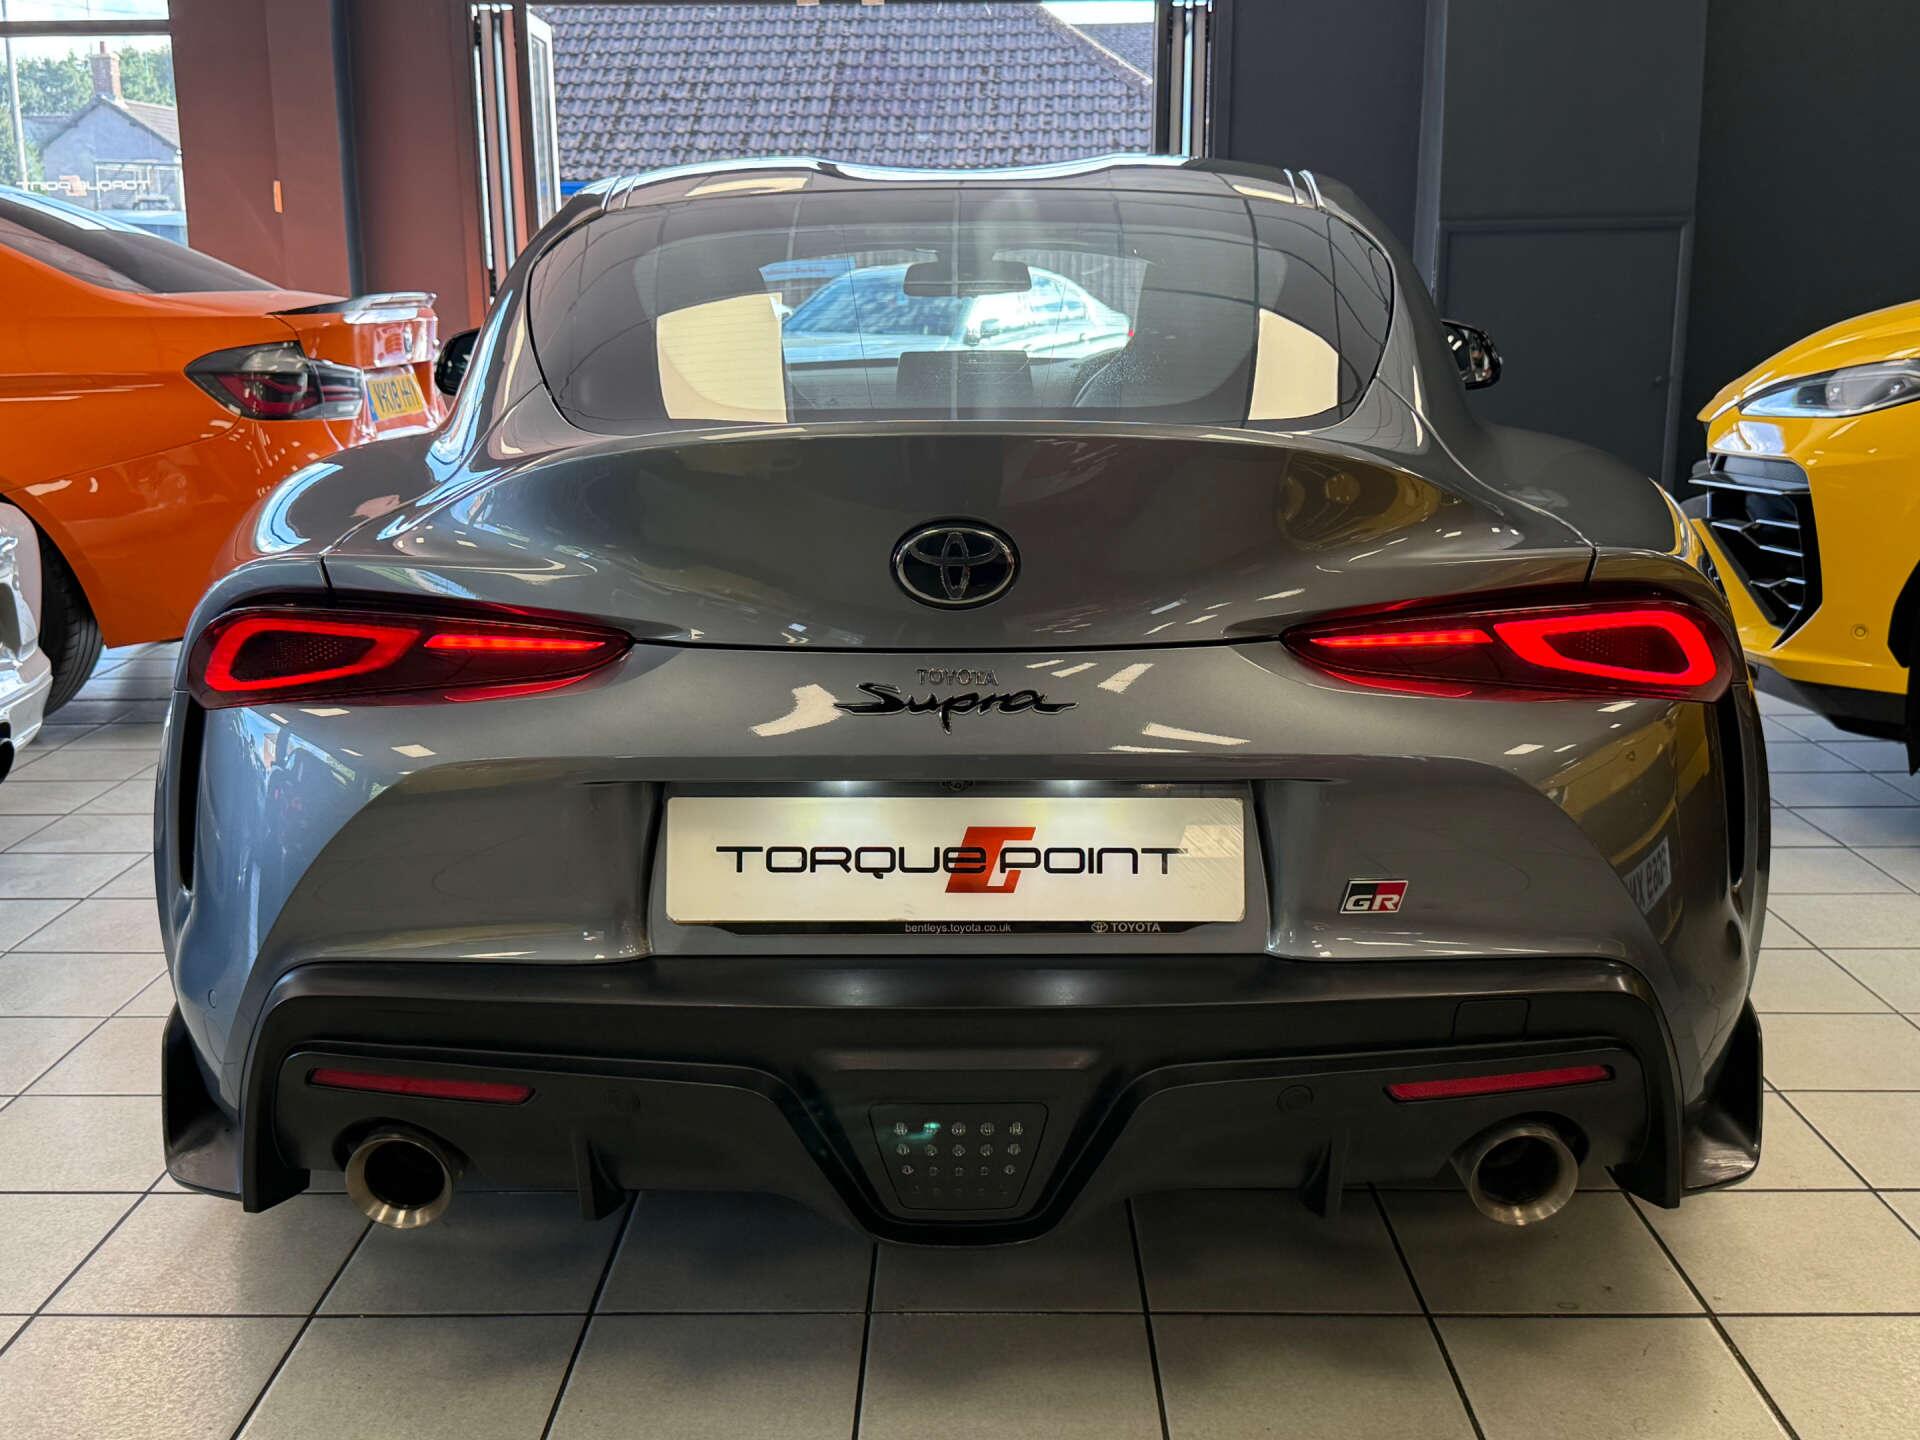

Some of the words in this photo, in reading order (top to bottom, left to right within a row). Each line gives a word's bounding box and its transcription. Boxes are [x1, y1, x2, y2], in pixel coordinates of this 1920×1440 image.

[916, 668, 999, 686] TOYOTA
[832, 683, 1078, 734] Supra
[715, 845, 987, 880] TORQUE
[999, 846, 1188, 875] POINT
[1345, 894, 1400, 911] GR
[904, 922, 1012, 934] bentleys.toyota.co.uk
[1110, 922, 1162, 933] TOYOTA
